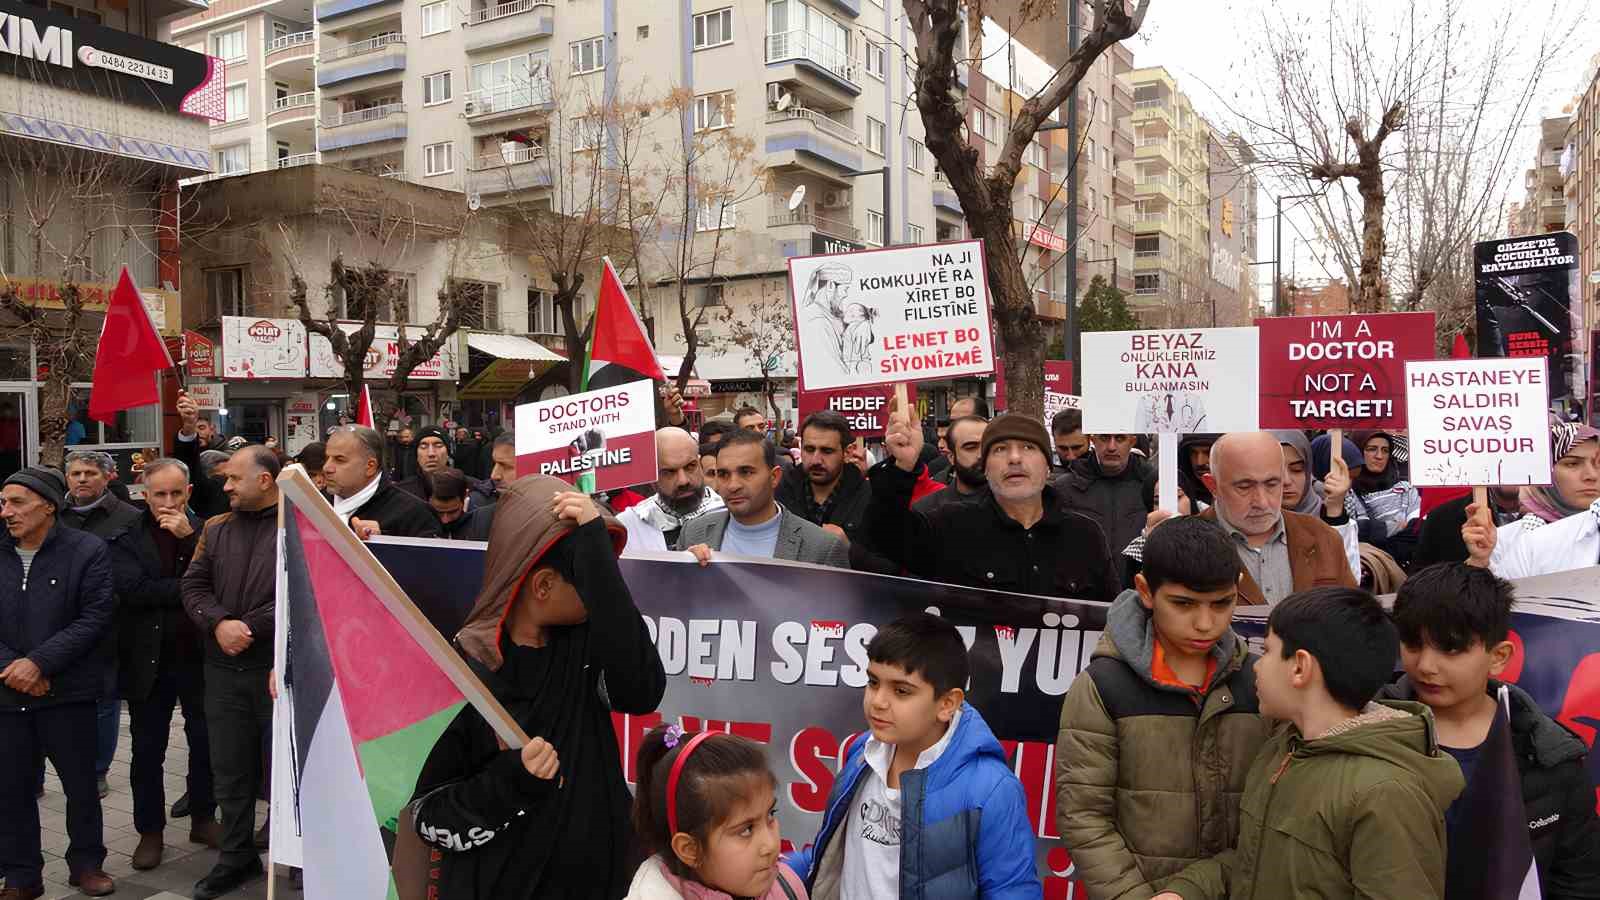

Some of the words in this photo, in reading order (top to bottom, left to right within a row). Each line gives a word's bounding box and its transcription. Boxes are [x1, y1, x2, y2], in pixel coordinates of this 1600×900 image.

[1497, 238, 1555, 252] GAZZE'DE
[932, 253, 954, 267] NA
[959, 251, 972, 264] JI
[1494, 247, 1559, 262] ÇOCUKLAR
[1482, 255, 1575, 272] KATLEDİLİYOR
[952, 268, 974, 282] RA
[955, 285, 975, 299] BO
[1310, 321, 1342, 339] I'M
[1355, 319, 1372, 338] A
[883, 331, 948, 351] LE'NET
[954, 328, 980, 343] BO
[1131, 333, 1203, 350] BEYAZ
[1289, 341, 1394, 360] DOCTOR
[1136, 362, 1198, 379] KANA
[1411, 369, 1542, 387] HASTANEYE
[1125, 380, 1209, 392] BULANMASIN
[1305, 373, 1354, 392] NOT
[1359, 373, 1377, 391] A
[539, 392, 629, 422] DOCTORS
[829, 397, 885, 411] HEDEF
[1290, 400, 1393, 418] TARGET!
[1433, 392, 1519, 409] SALDIRI
[549, 419, 587, 434] STAND
[590, 412, 620, 426] WITH
[849, 413, 882, 430] EĞİL
[1442, 415, 1512, 434] SAVAŞ
[1423, 437, 1534, 457] SUÇUDUR
[540, 447, 632, 475] PALESTINE
